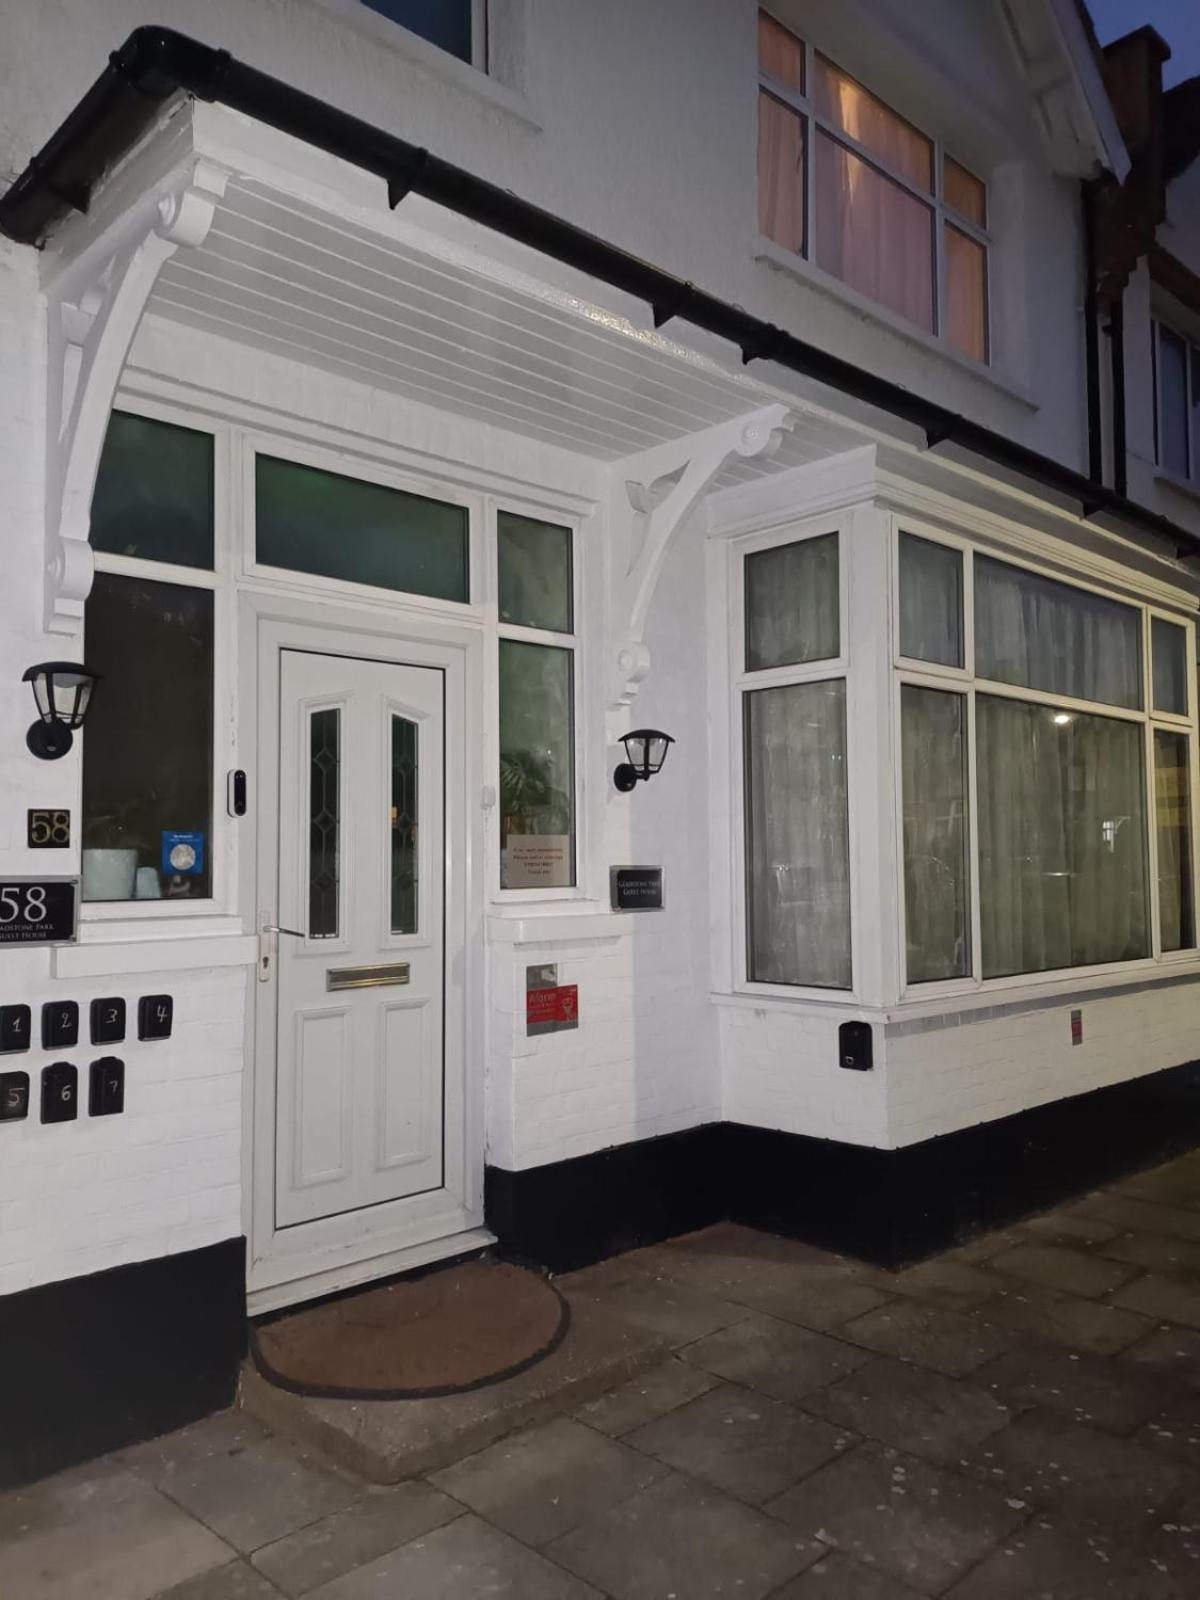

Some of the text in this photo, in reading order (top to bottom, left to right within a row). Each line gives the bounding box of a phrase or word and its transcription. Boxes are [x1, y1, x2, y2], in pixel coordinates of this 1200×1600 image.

[31, 811, 70, 843] 58
[0, 886, 46, 922] 58
[61, 1012, 72, 1028] 2
[105, 1008, 118, 1024] 3
[156, 1004, 168, 1024] 4
[12, 1017, 22, 1033] 1
[61, 1085, 72, 1101] 6
[109, 1080, 118, 1093] 7
[7, 1087, 25, 1107] 5
